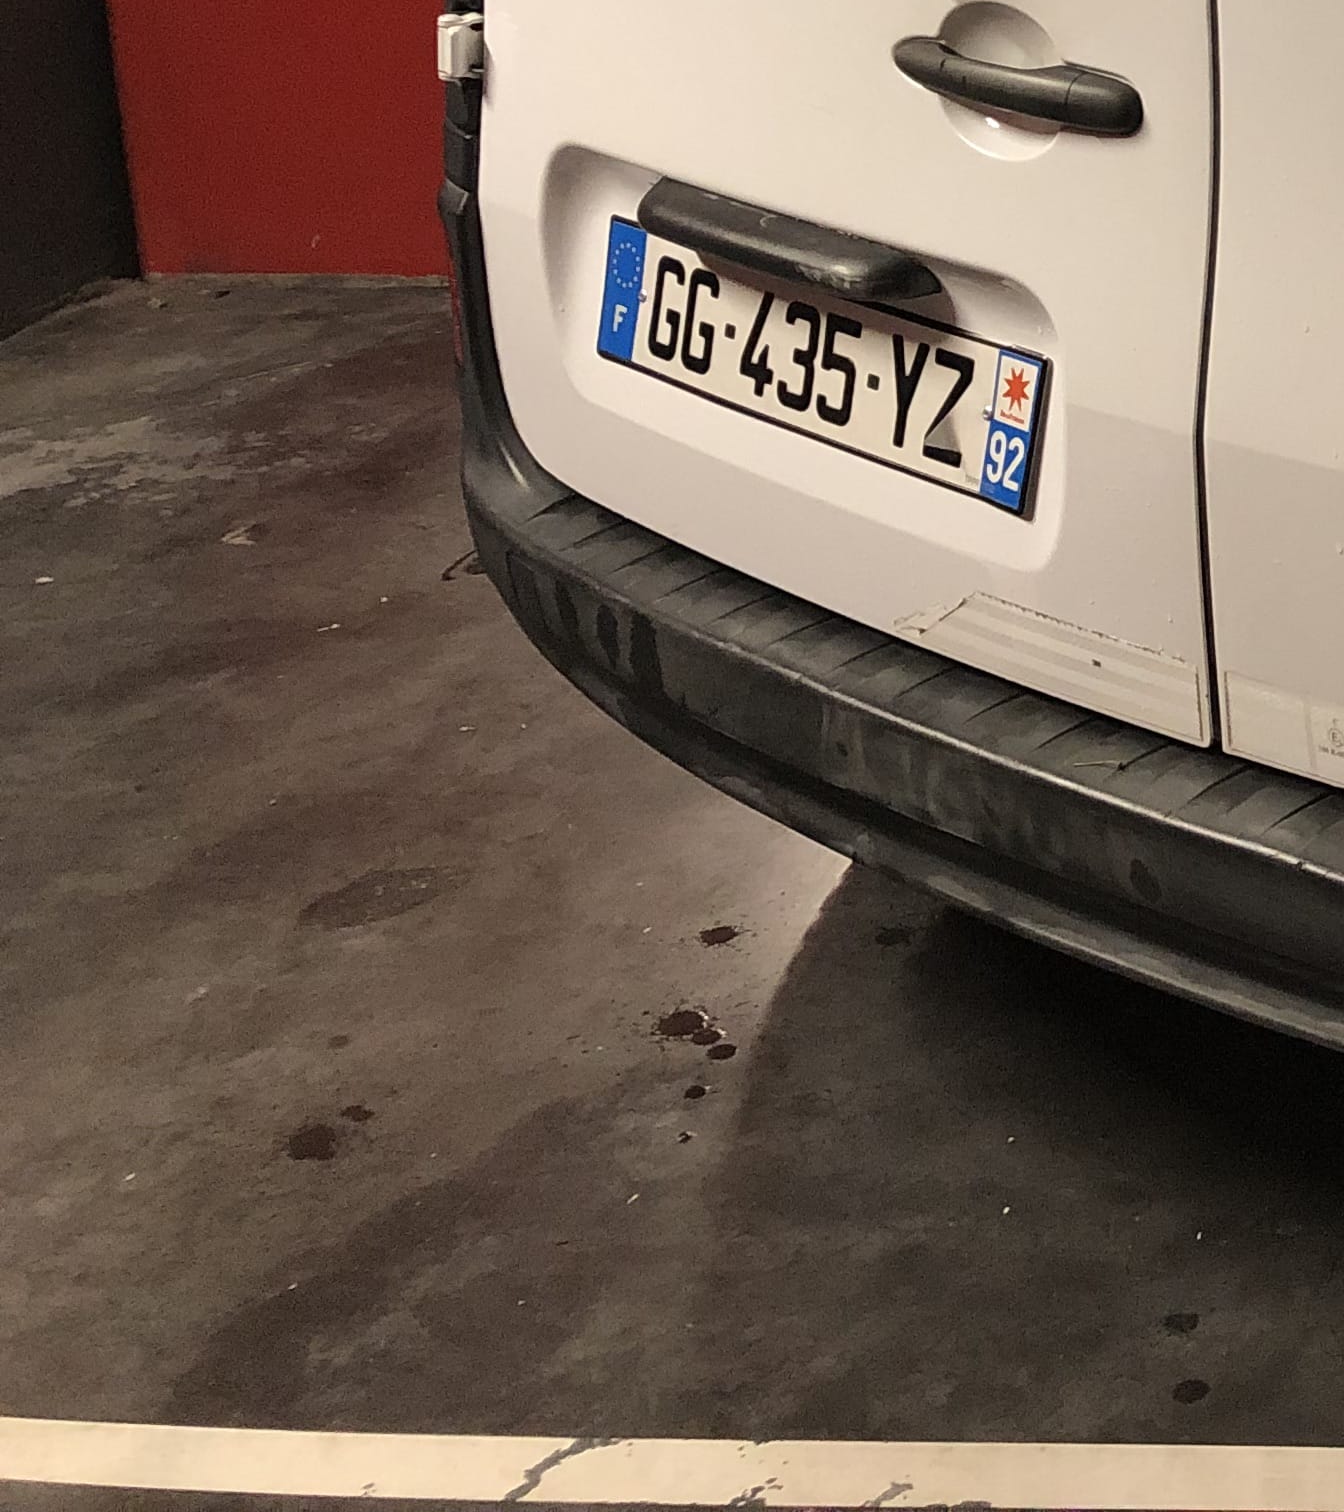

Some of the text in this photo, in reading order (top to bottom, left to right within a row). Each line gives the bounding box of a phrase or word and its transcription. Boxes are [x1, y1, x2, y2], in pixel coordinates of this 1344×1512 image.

[611, 303, 628, 334] F
[648, 256, 975, 468] GG-435-YZ
[985, 429, 1026, 492] 92
